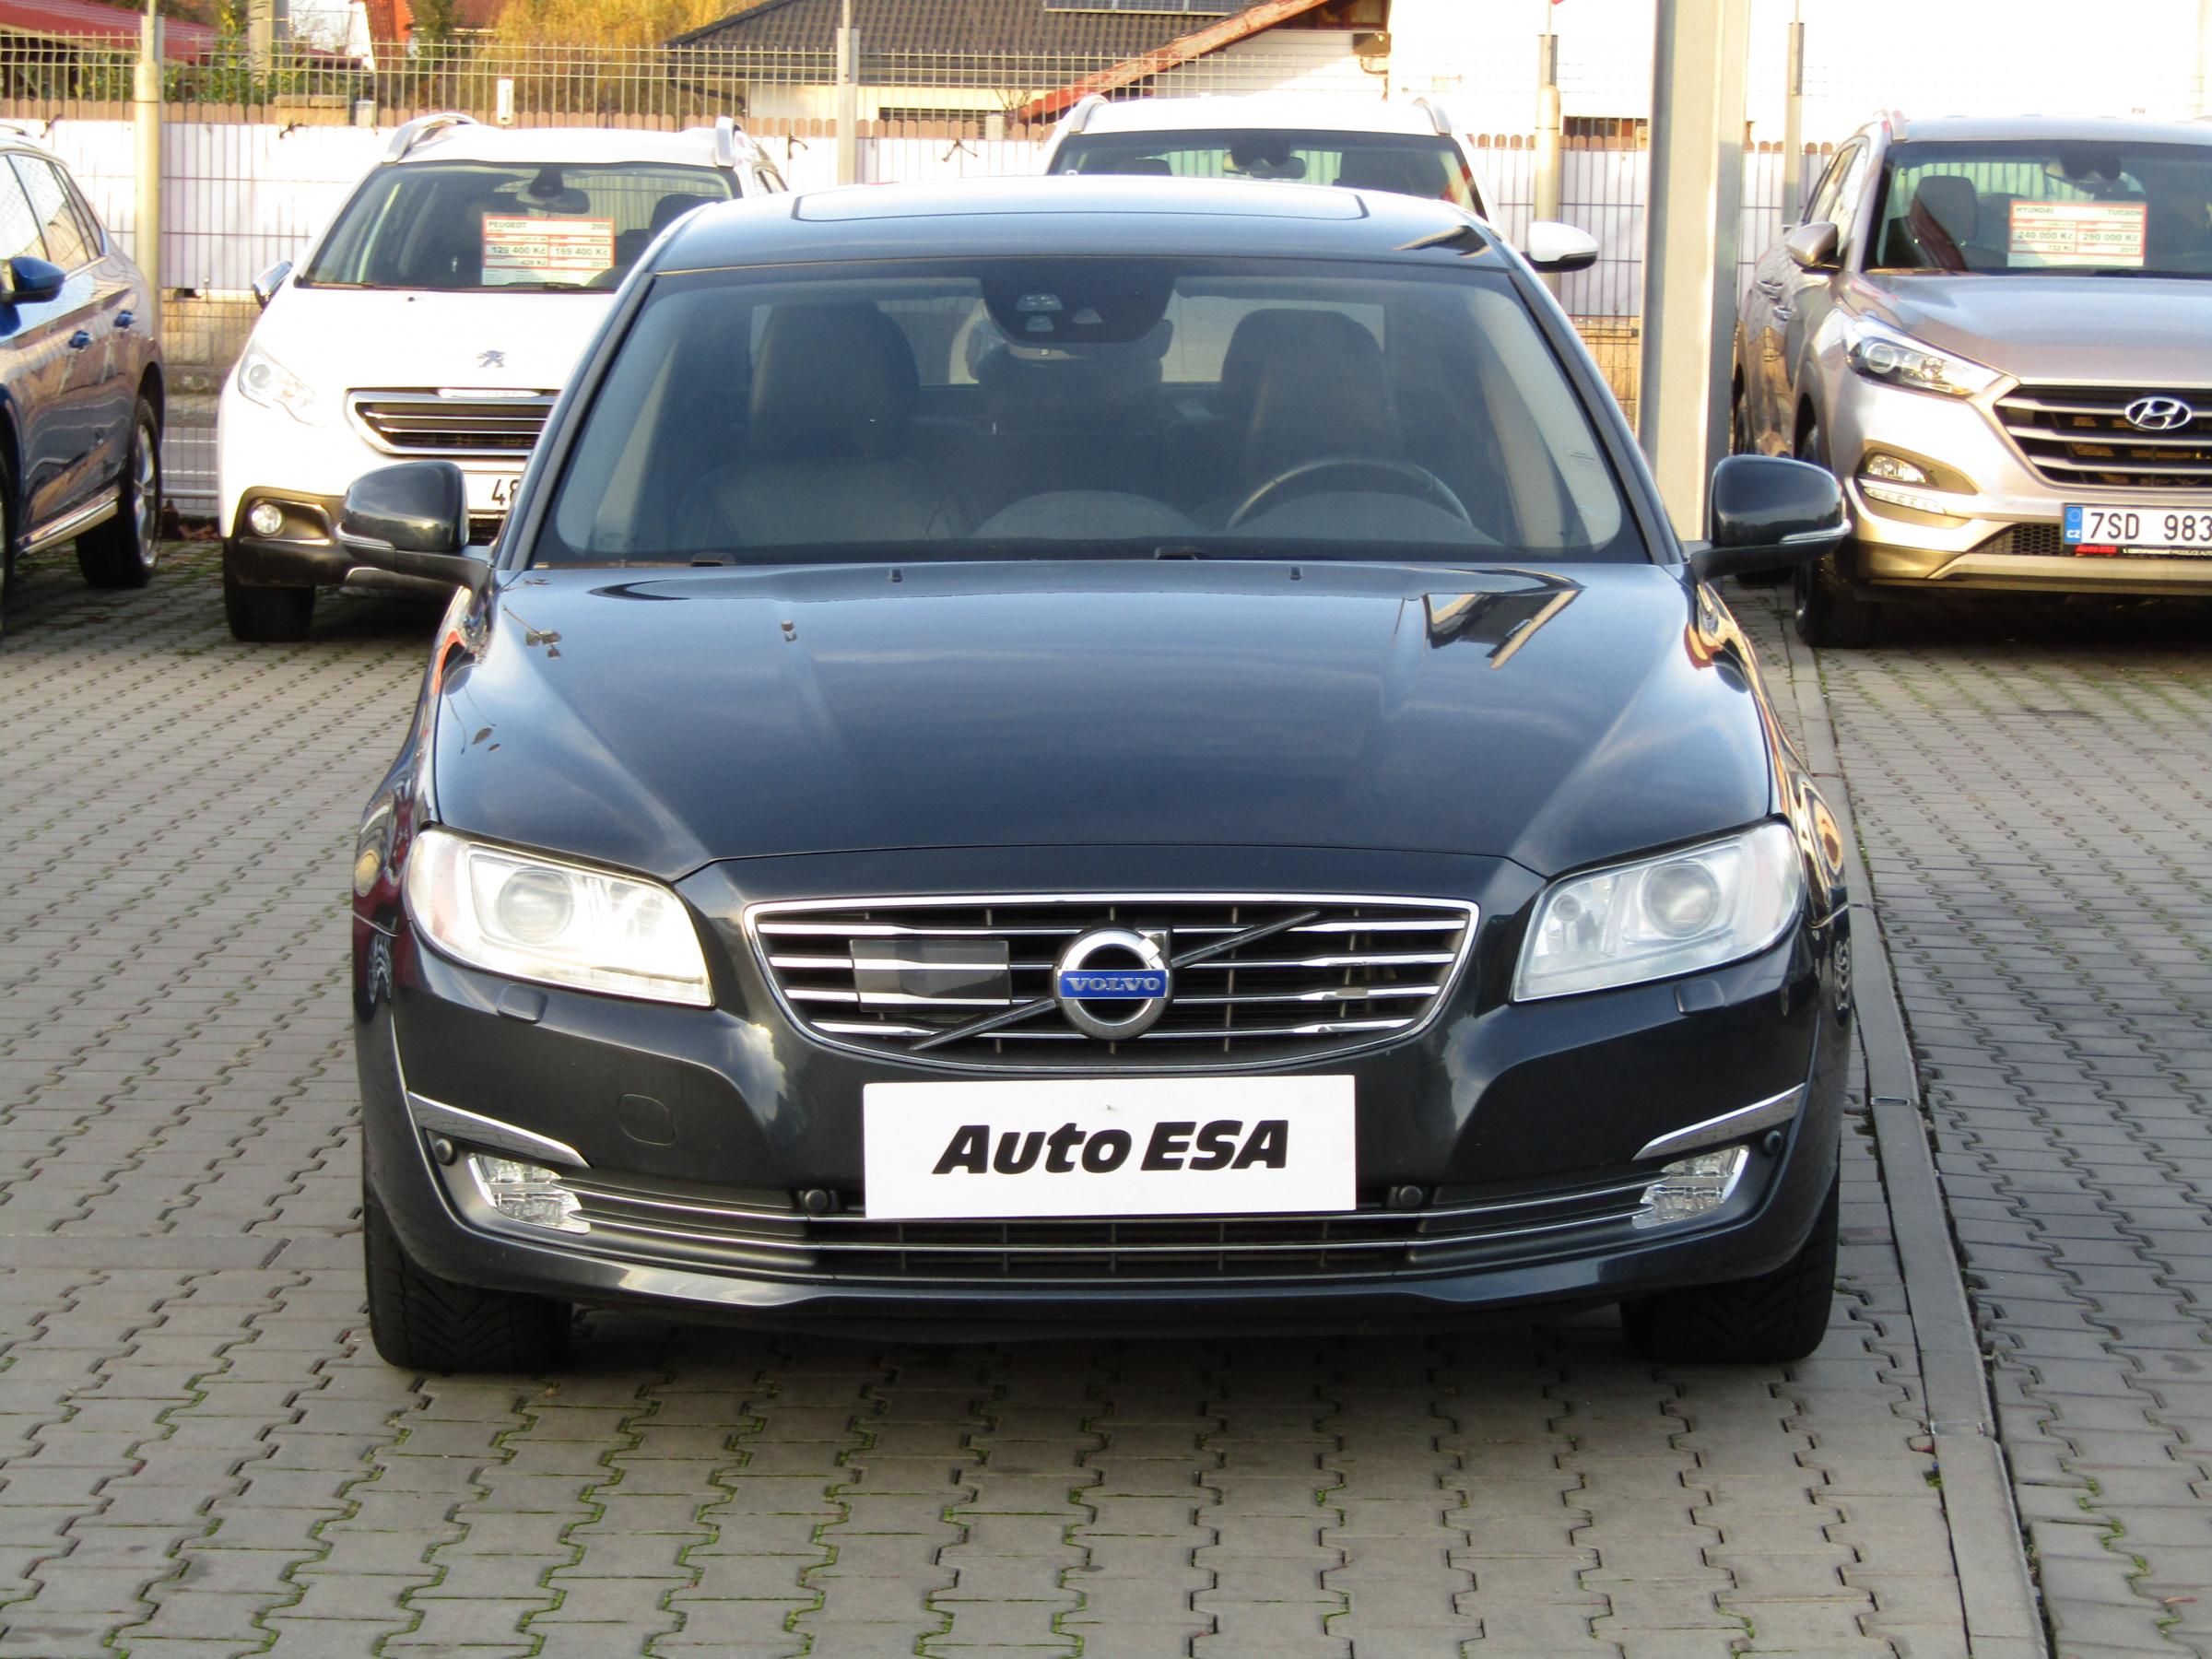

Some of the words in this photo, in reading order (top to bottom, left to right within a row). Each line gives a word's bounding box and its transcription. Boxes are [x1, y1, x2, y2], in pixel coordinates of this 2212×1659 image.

[513, 246, 530, 254] 400
[575, 247, 593, 255] 400
[2089, 512, 2140, 540] 7SD
[2163, 514, 2212, 542] 983
[2066, 529, 2081, 539] CZ
[1065, 978, 1161, 992] VOLVO
[931, 1122, 1132, 1175] Auto
[1139, 1119, 1289, 1172] ESA
